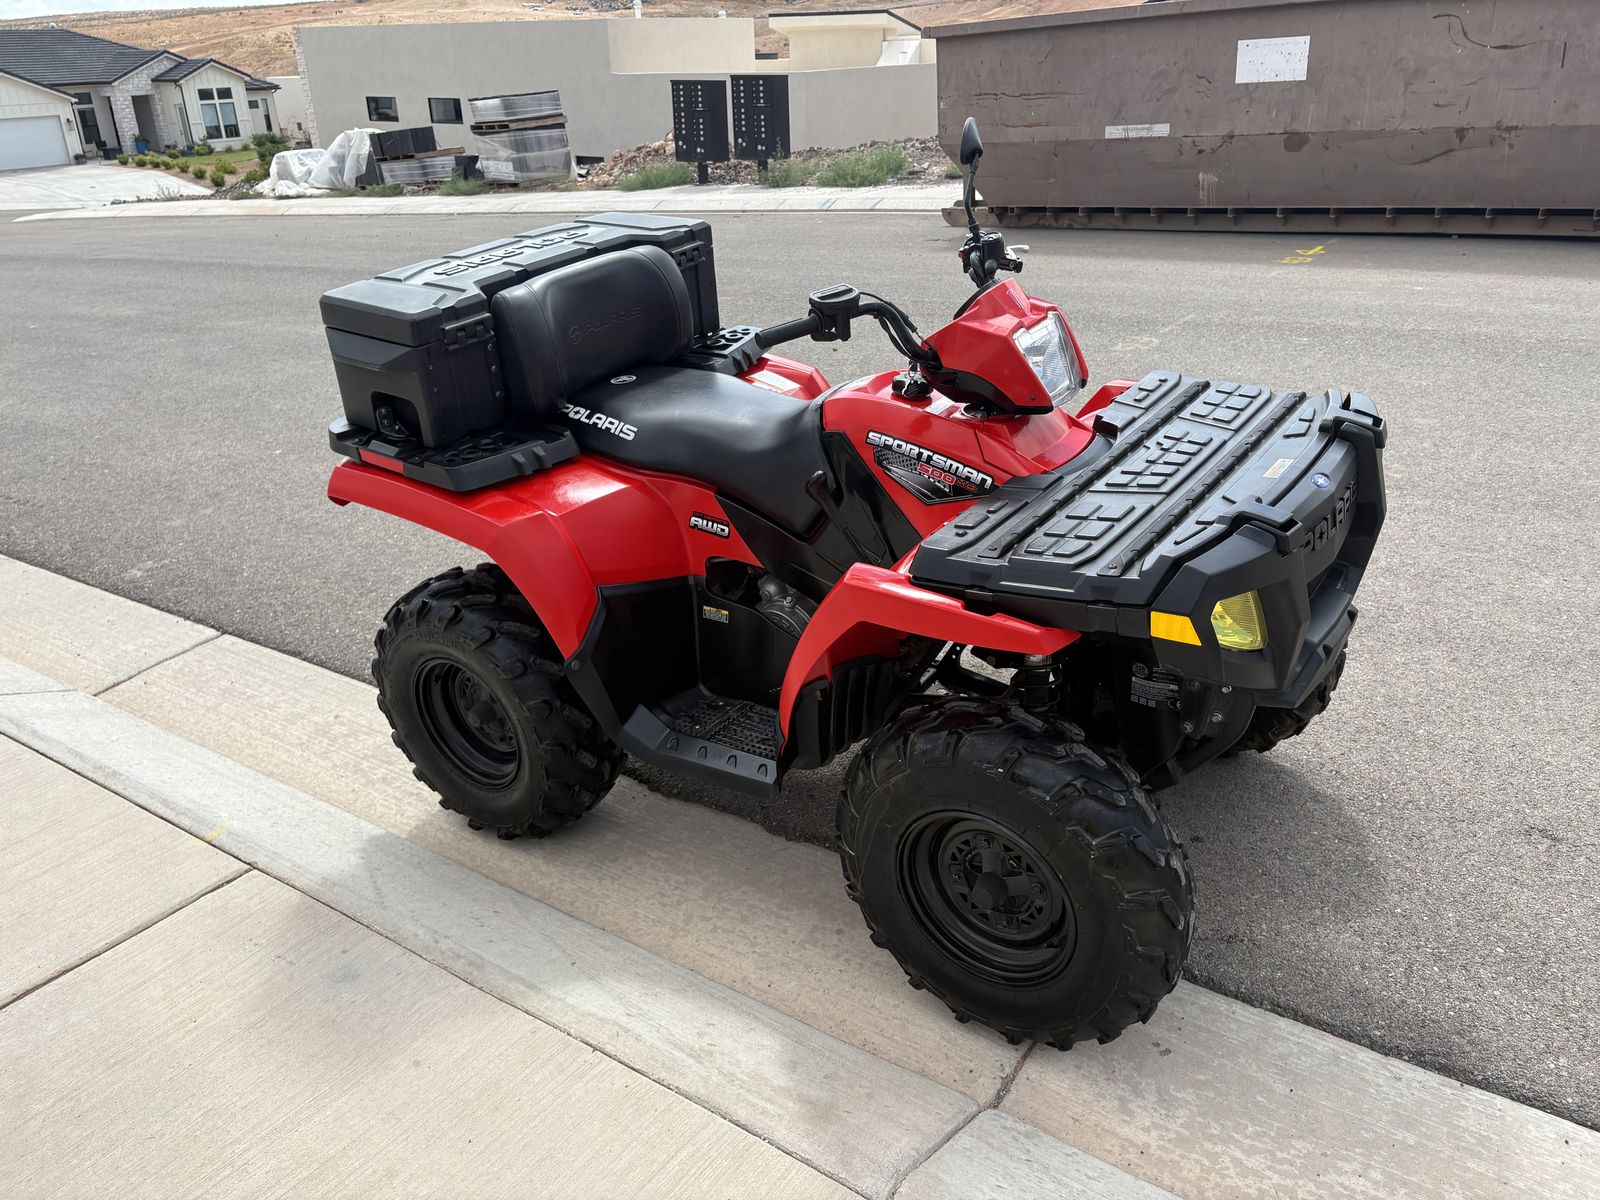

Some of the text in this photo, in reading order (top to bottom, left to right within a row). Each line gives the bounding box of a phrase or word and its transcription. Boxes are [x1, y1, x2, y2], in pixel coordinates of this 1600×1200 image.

[866, 431, 993, 489] SPORTSMAN
[917, 462, 956, 486] 500
[690, 516, 729, 537] AWD
